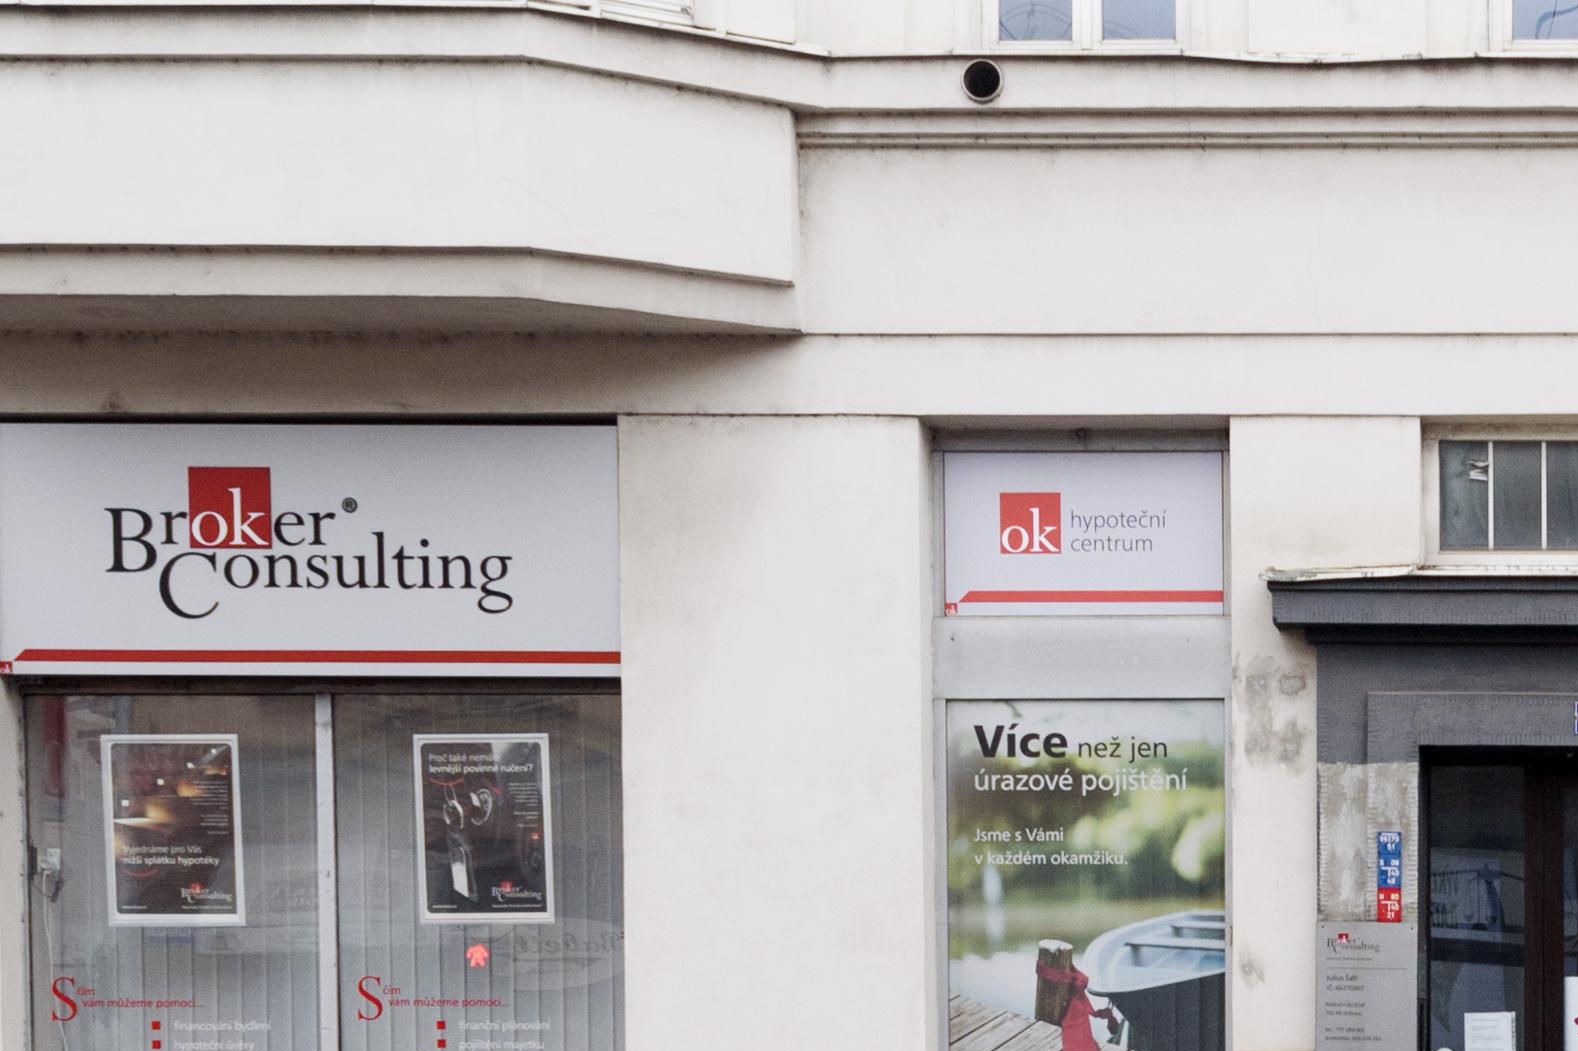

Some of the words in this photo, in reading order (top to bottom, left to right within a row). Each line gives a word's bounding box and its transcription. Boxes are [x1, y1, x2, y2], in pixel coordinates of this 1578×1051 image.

[104, 487, 336, 574] Broker
[1001, 507, 1060, 553] ok
[1070, 509, 1167, 538] hypoteční
[1070, 535, 1153, 553] centrum
[158, 531, 514, 620] Consulting
[974, 722, 1069, 759] Více
[1078, 737, 1122, 759] než
[1128, 737, 1168, 764] jen
[974, 768, 1073, 792] úrazové
[1081, 767, 1188, 797] pojištění
[974, 828, 1012, 843] Jsme
[1014, 831, 1022, 842] s
[1026, 827, 1064, 843] Vámi
[974, 854, 983, 865] v
[986, 850, 1047, 865] každém
[1051, 850, 1129, 866] okamžiku.
[52, 976, 77, 1021] S
[77, 985, 96, 996] čím
[82, 998, 105, 1008] vám
[107, 997, 153, 1008] můžeme
[357, 975, 383, 1021] S
[382, 985, 400, 995] čím
[388, 997, 410, 1007] vám
[413, 997, 459, 1007] můžeme
